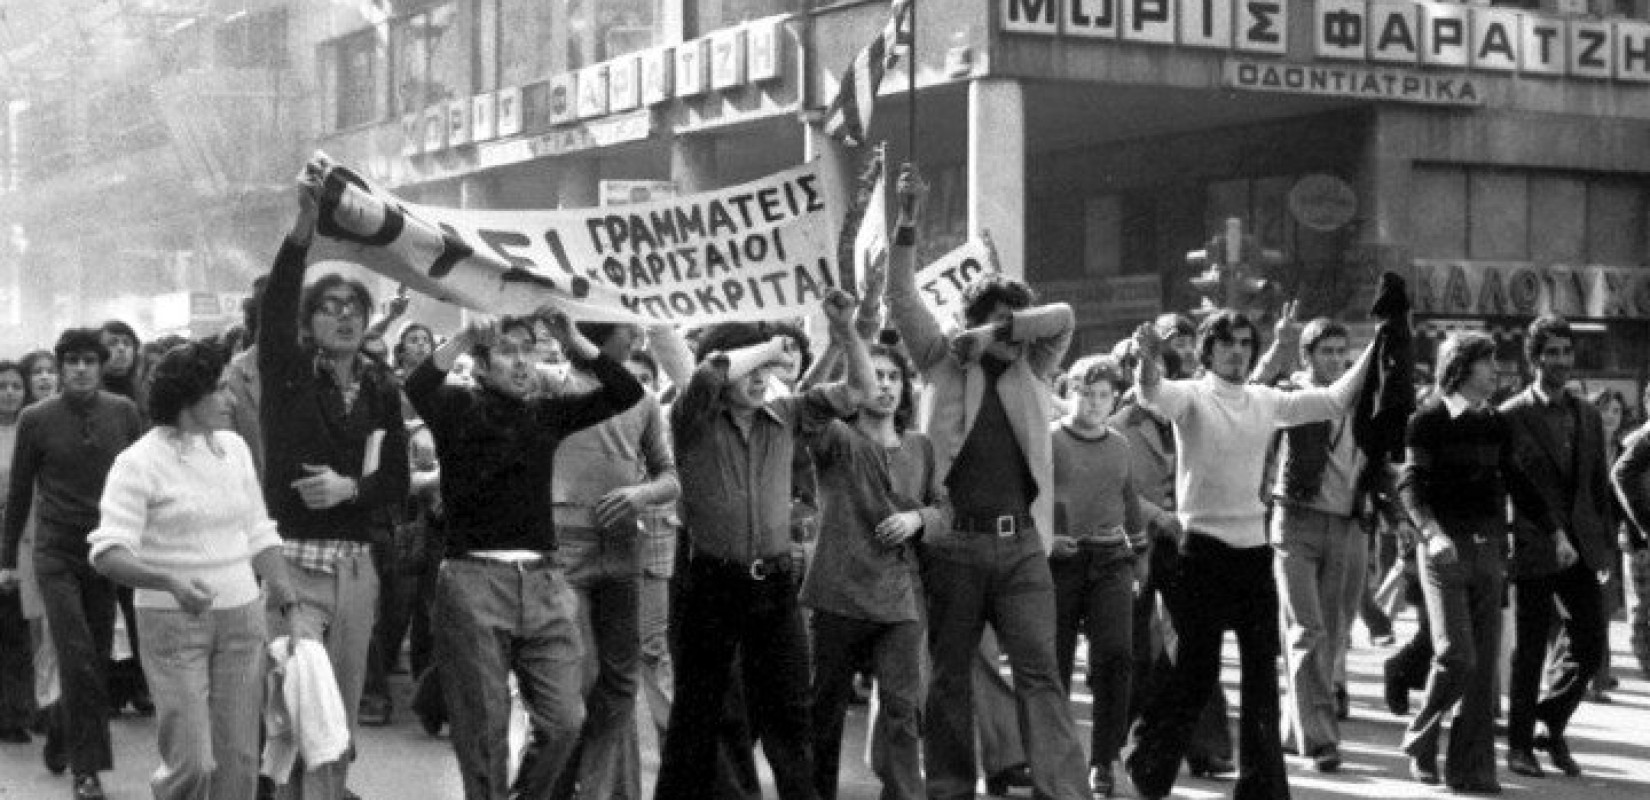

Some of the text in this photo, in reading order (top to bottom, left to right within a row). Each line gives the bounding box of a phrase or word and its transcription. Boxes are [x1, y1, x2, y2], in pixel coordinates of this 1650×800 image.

[1007, 0, 1650, 72] ΜΩΡΙΣ ΦΑΡΑΤΖΗ
[1238, 63, 1477, 100] ΟΔΟΝΤΙΑΤΡΙΚΑ
[586, 174, 825, 255] ΓΡΑΜΜΑΤΕΙΣ
[602, 227, 786, 288] ΦΑΡΙΣΑΙΟΙ
